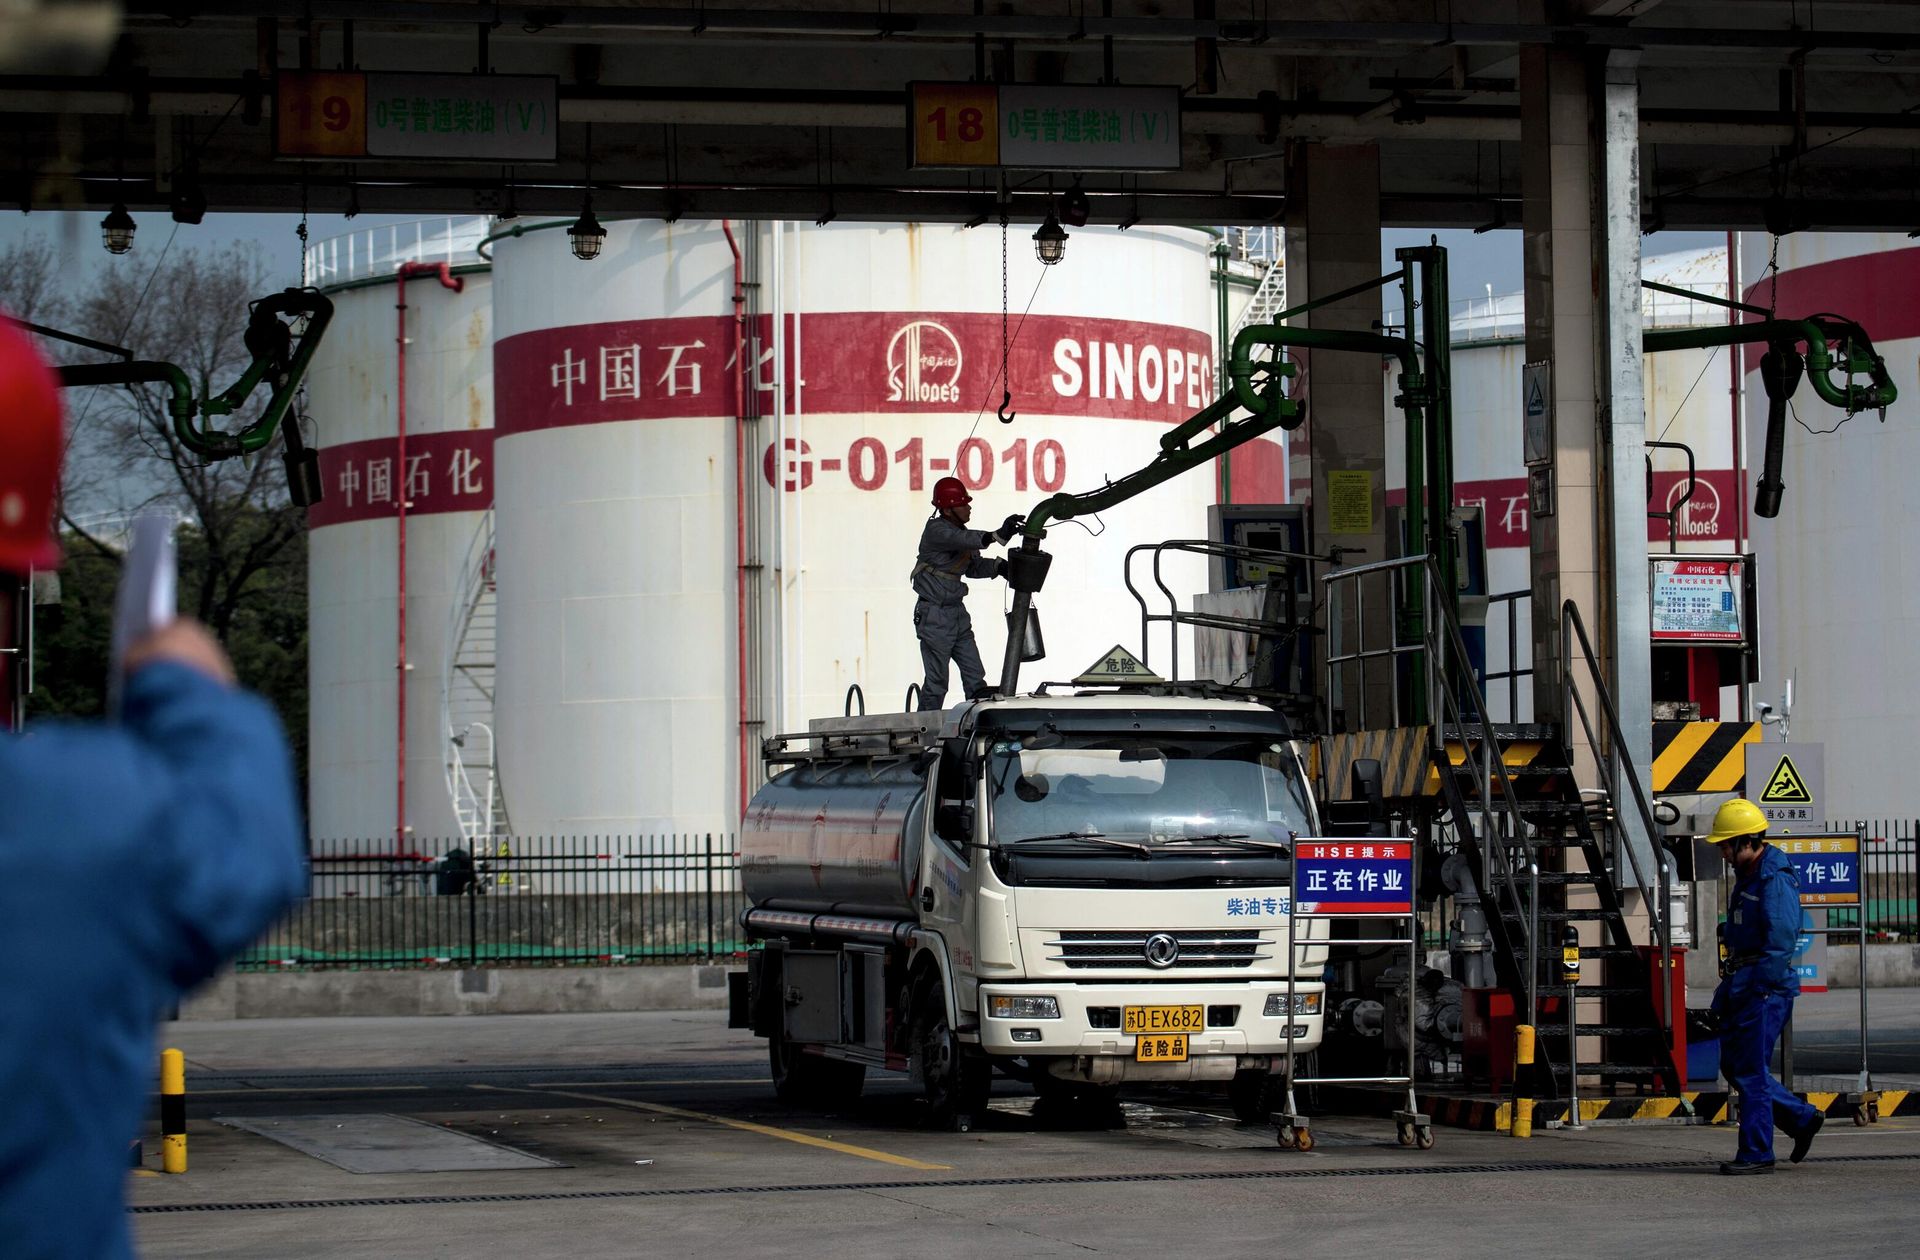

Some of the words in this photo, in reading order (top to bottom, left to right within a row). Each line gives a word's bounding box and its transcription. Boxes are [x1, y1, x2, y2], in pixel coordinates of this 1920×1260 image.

[290, 96, 351, 131] 19
[927, 107, 984, 142] 18
[1052, 338, 1211, 408] SINOPEC
[339, 448, 483, 507] 中国石化
[763, 437, 1067, 492] G-01-010
[1687, 566, 1716, 574] 中国石化
[1105, 658, 1136, 673] 危险
[1306, 869, 1403, 892] 正在作业
[1141, 1039, 1184, 1057] 危险品
